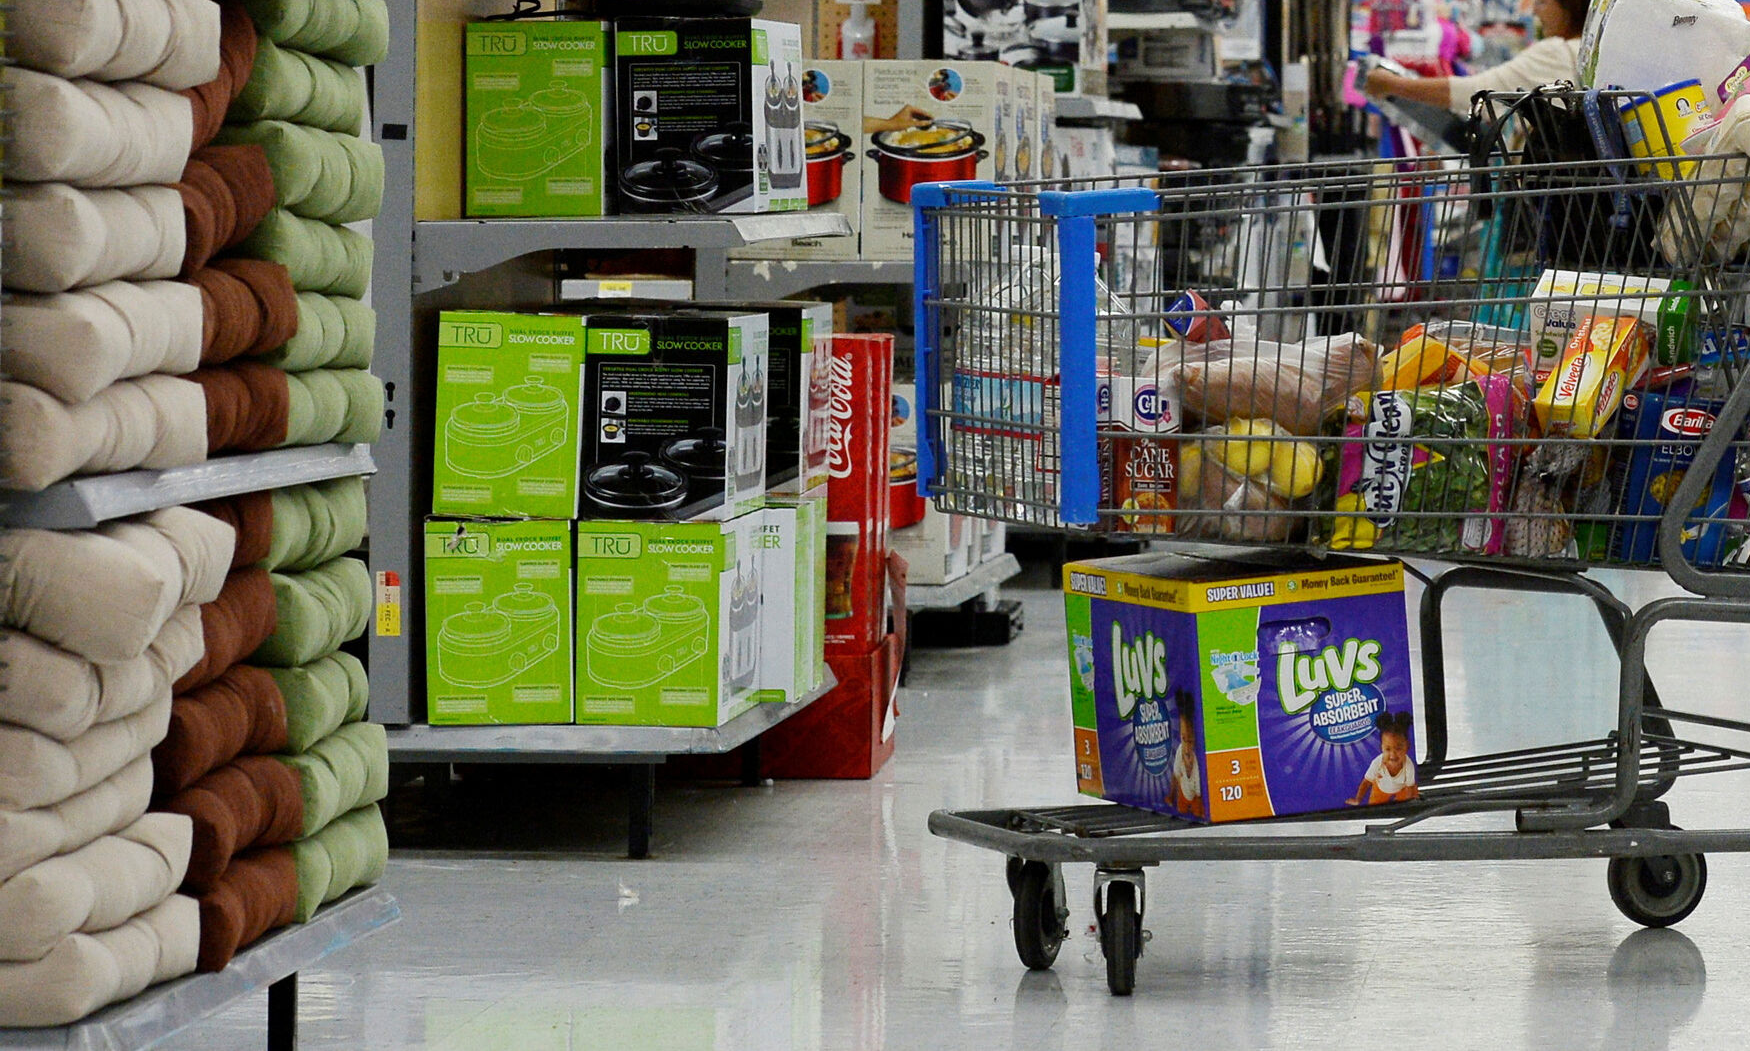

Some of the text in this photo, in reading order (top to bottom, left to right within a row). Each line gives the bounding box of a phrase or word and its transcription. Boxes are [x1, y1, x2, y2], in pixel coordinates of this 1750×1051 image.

[684, 39, 748, 49] SLOW COOKER
[508, 335, 575, 346] SLOW COOKER
[656, 340, 723, 350] SLOW COOKER
[1558, 355, 1586, 398] Velveeta
[1130, 445, 1171, 464] CANE
[1124, 462, 1175, 478] SUGAR
[523, 542, 563, 552] COOKER
[647, 544, 714, 554] SLOW COOKER
[1206, 581, 1275, 602] SUPER VALUE!
[1301, 576, 1350, 591] Money Back
[1324, 689, 1363, 709] SUPER
[1312, 698, 1380, 727] ABSORBENT
[1230, 759, 1241, 775] 3
[1219, 784, 1242, 801] 120
